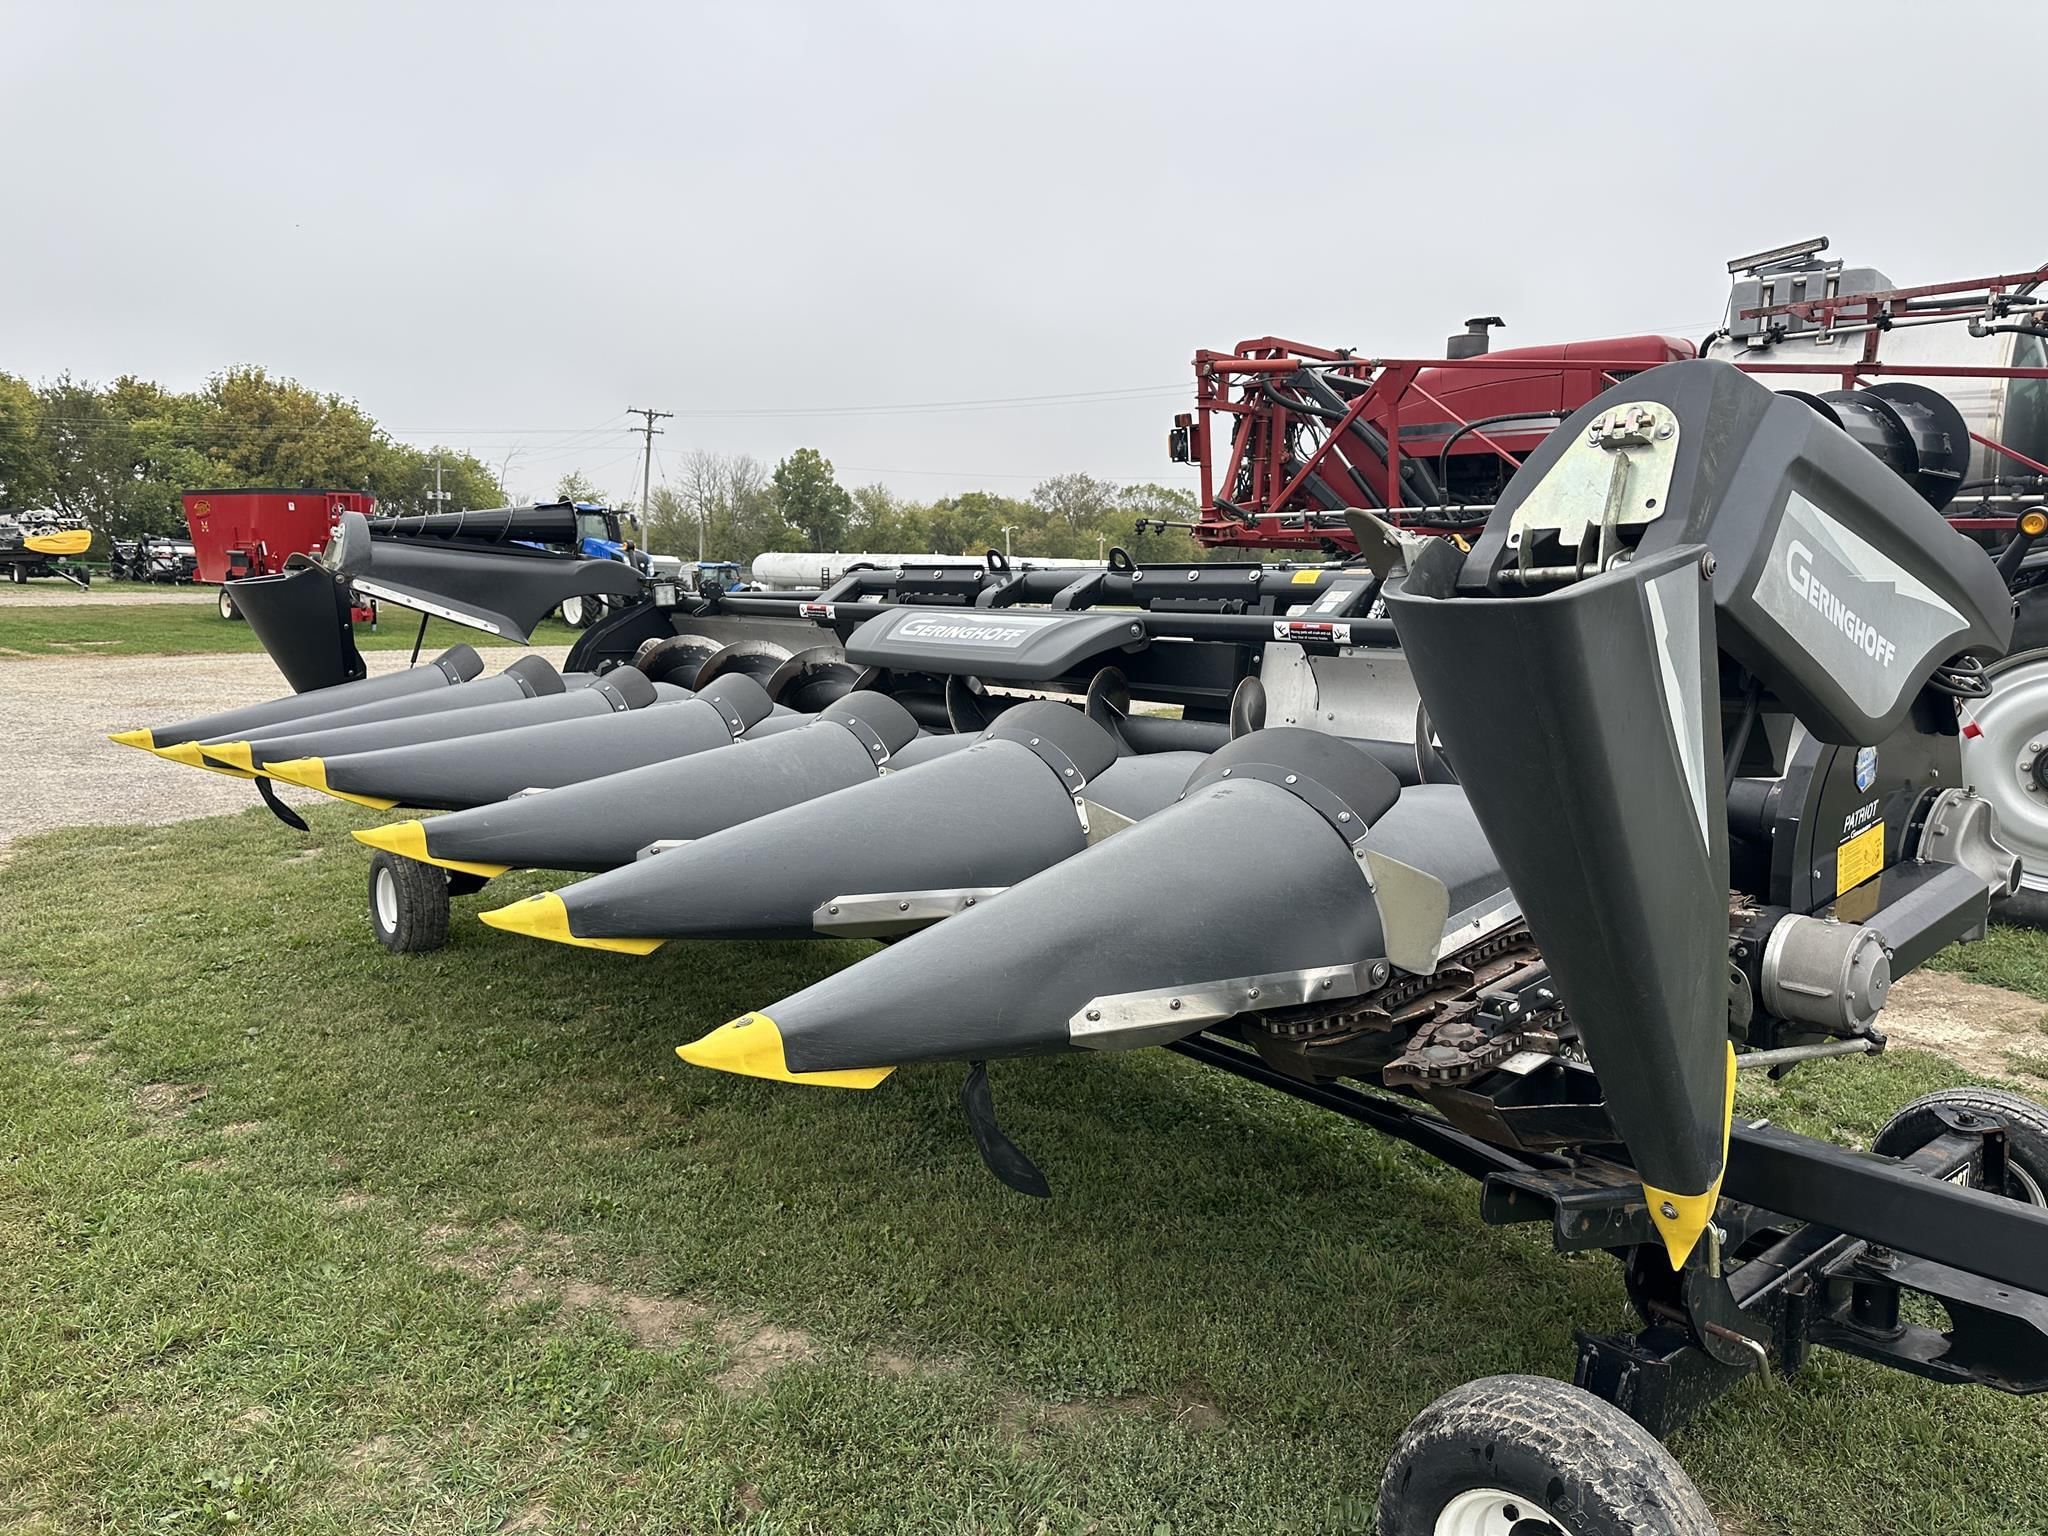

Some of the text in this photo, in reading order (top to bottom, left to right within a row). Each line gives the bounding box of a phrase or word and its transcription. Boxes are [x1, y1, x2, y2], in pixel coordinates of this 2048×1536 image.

[1787, 540, 1896, 667] GERINGHOFF
[900, 618, 1026, 641] GERINGHOFF
[1844, 798, 1880, 833] PATRIOT
